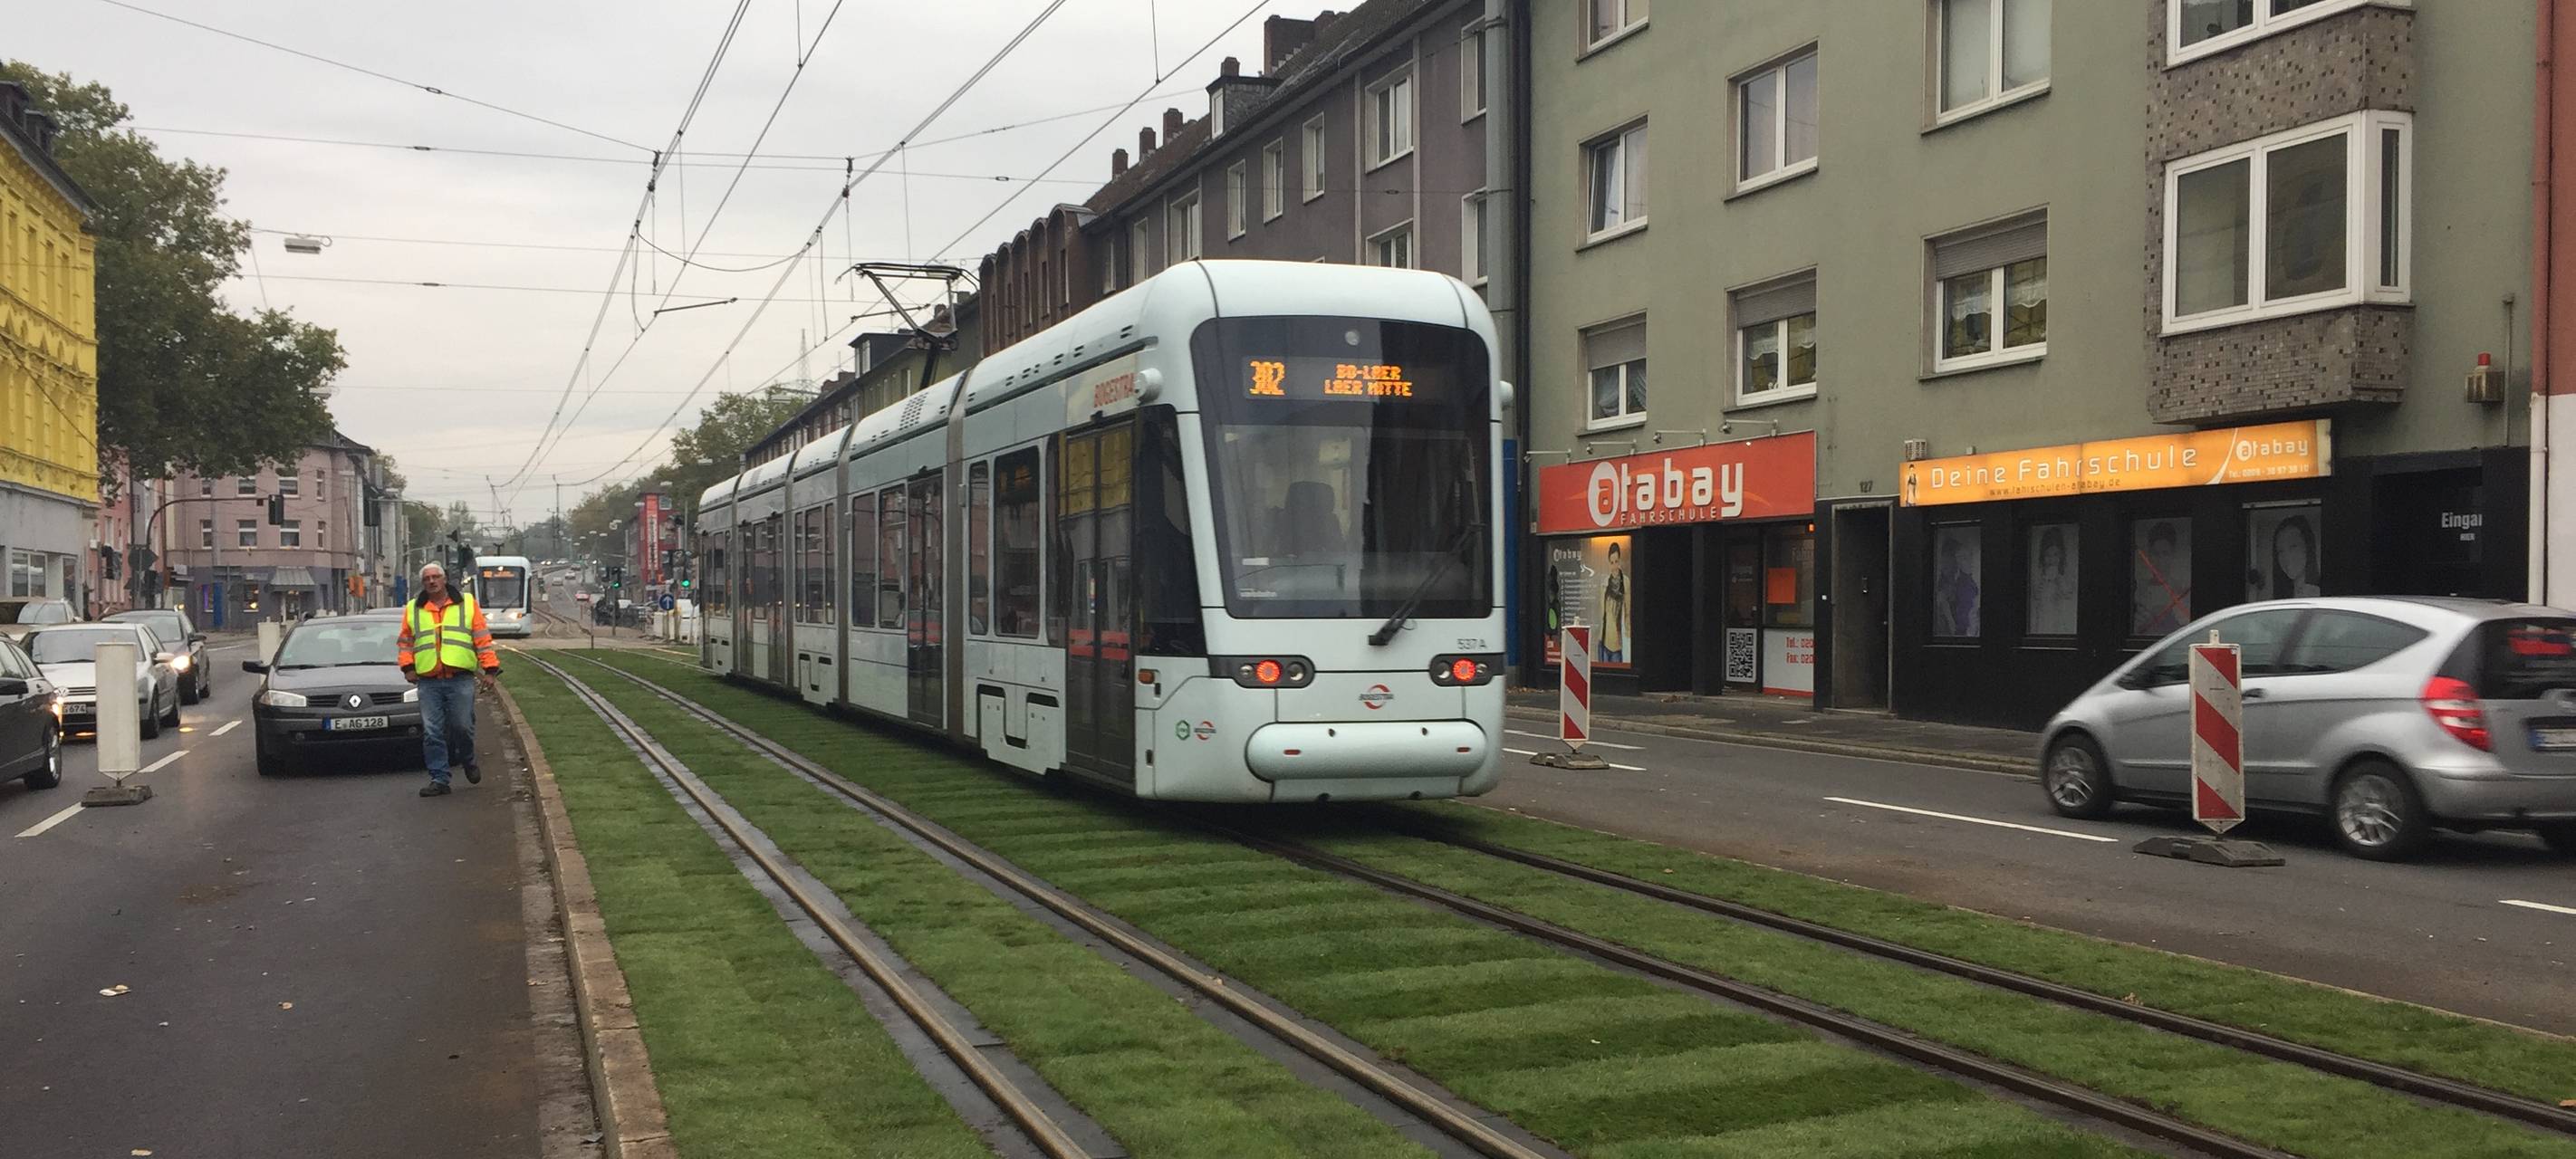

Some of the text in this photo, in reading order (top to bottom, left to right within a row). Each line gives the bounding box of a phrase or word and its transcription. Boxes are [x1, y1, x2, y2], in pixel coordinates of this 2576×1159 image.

[1367, 381, 1413, 397] MITTE
[1931, 445, 2196, 489] Deine Fahrschule
[1620, 505, 1717, 525] FAHRSCHULE
[334, 720, 341, 730] E
[363, 717, 384, 728] 128
